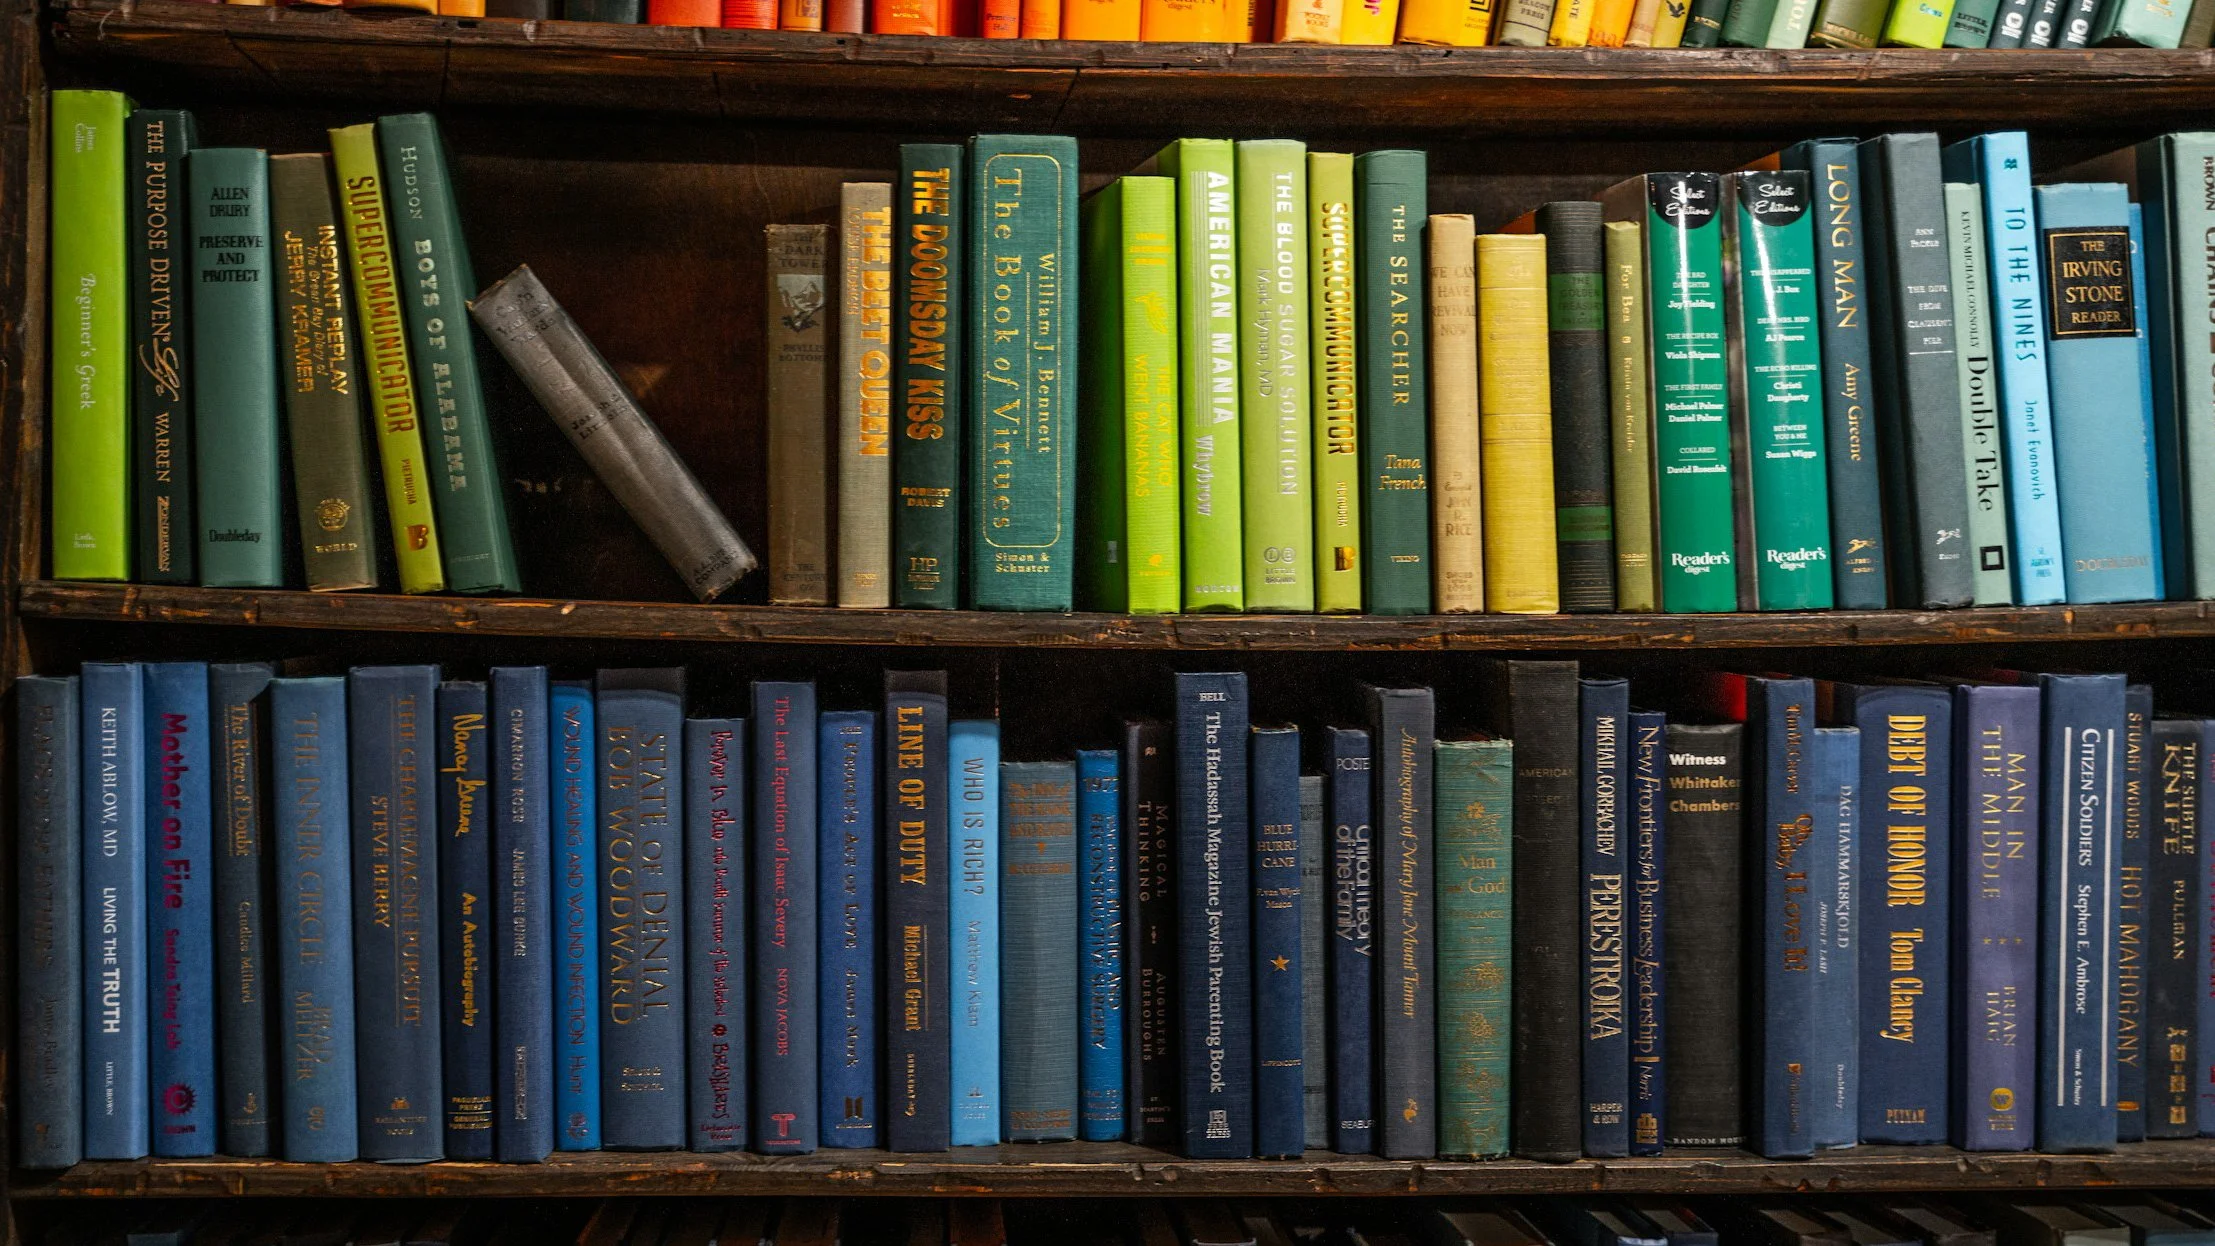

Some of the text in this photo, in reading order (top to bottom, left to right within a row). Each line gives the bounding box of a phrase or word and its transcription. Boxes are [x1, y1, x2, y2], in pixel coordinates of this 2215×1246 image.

[73, 122, 84, 153] Collins
[86, 125, 95, 151] James
[209, 204, 250, 218] DRURY
[211, 187, 249, 201] ALLEN
[199, 235, 264, 250] PRESERVE
[202, 269, 260, 283] PROTECT
[216, 252, 246, 265] AND
[2062, 261, 2123, 279] IRVING
[2079, 241, 2105, 252] THE
[345, 175, 415, 434] SUPERCOMMUNICATOR
[400, 146, 468, 491] HUDSON BOYS OF ALABAMA
[905, 167, 951, 441] THE DOOMSDAY KISS
[1206, 171, 1237, 425] AMERICAN MANIA
[1389, 206, 1411, 406] THE SEARCHER
[1827, 163, 1865, 461] LONG MAN Amy Greene
[2005, 207, 2036, 362] TO THE NINES
[2065, 285, 2124, 303] STONE
[2071, 309, 2121, 324] READER
[73, 273, 95, 410] Beginner's Greek
[857, 206, 891, 457] THE BEET QUEEN
[985, 168, 1024, 529] The Book of Virtues
[1033, 253, 1056, 454] William J. Bennett
[1275, 172, 1298, 495] THE BLOOD SUGAR SOLUTION
[1320, 201, 1356, 456] SUPERCOMMUNICATOR
[1620, 264, 1636, 453] For Bea Kristin von Kreisler
[1960, 211, 1997, 511] KEVIN MICHAEL CONNOLLY Double Take
[1192, 435, 1214, 517] Whybrow
[2024, 400, 2045, 500] Janet Evanovich
[901, 487, 952, 497] ROBERT
[995, 552, 1050, 562] Simon &
[995, 563, 1050, 573] Schuster
[1671, 551, 1731, 567] Reader's
[1684, 566, 1711, 575] digest
[1767, 546, 1827, 563] Reader's
[1779, 562, 1807, 572] digest
[1199, 692, 1226, 701] BELL
[1203, 711, 1223, 743] The
[1204, 748, 1225, 825] Hadassah
[1668, 753, 1727, 766] Witness
[1668, 775, 1741, 789] Whittaker
[2161, 742, 2182, 856] KNIFE
[2181, 742, 2197, 855] THE SUBTLE
[1263, 824, 1293, 835] BLUE
[1668, 799, 1741, 812] Chambers
[1981, 726, 2003, 900] THE MIDDLE
[2006, 753, 2026, 861] MAN IN
[370, 795, 391, 929] STEVE BERRY
[606, 726, 635, 1027] BOB WOODWARD
[639, 733, 671, 1018] STATE OF DENIAL
[769, 697, 791, 1056] The Last Equation of Isaac Severy NOVA JACOBS
[896, 706, 927, 1032] LINE OF DUTY Michael Grant
[962, 757, 985, 1028] WHO IS RICH? Matthew Klam
[1137, 801, 1152, 903] THINKING
[1154, 806, 1168, 898] MAGICAL
[1202, 828, 1224, 907] Magazine
[1261, 857, 1297, 868] CANE
[1589, 716, 1622, 1041] MIKHAIL GORBACHEV PERESTROIKA
[1880, 714, 1927, 1044] DEBT OF HONOR Tom Clancy
[2073, 728, 2101, 1014] CITIZEN SOLDIERS Stephen E. Ambrose
[98, 707, 121, 1115] KEITH ABLOW, MD LIVING THE TRUTH LITTLE, BROWN
[1203, 908, 1225, 962] Jewish
[1633, 724, 1661, 1101] New Frontiers for Business Leadership Norris
[1783, 871, 1808, 973] I Love It!
[2170, 880, 2186, 961] PULLMAN
[1141, 968, 1155, 1061] BURROUGHS
[1154, 973, 1167, 1056] AUGUSTEN
[1205, 967, 1224, 1046] Parenting
[1985, 991, 2001, 1043] HAIG
[2000, 985, 2017, 1048] BRIAN
[1209, 1049, 1226, 1093] Book
[1835, 1064, 1846, 1111] Doubleday
